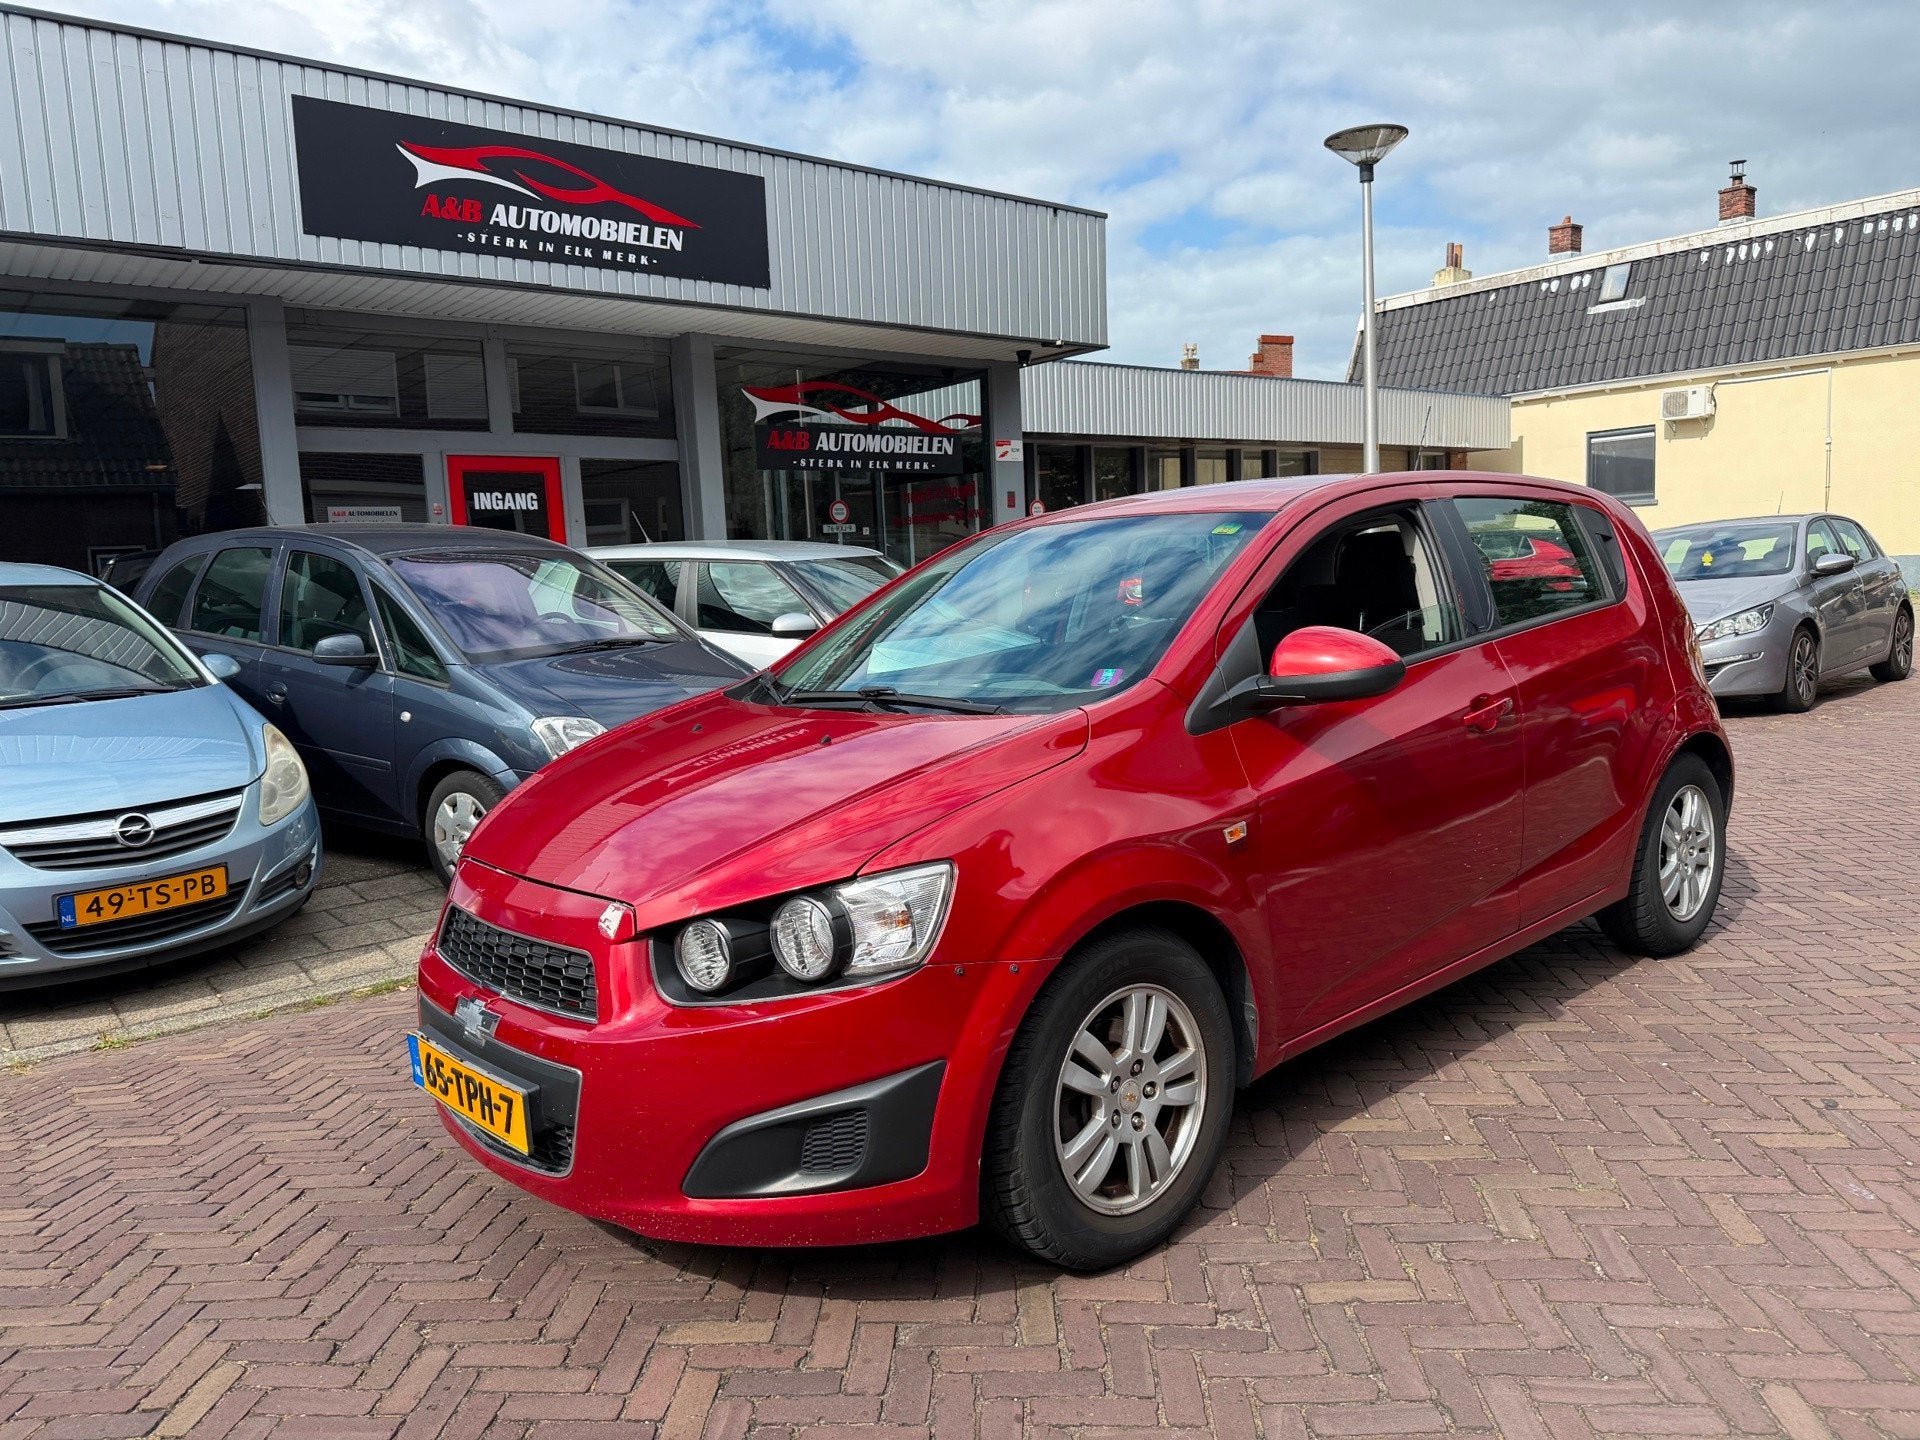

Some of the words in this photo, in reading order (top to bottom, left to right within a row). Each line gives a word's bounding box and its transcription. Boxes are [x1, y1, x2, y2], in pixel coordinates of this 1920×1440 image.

[421, 193, 483, 224] A&B
[489, 203, 684, 251] AUTOMOBIELEN
[538, 241, 554, 253] IN
[564, 245, 593, 258] ELK
[767, 430, 810, 450] A&B
[815, 432, 954, 455] AUTOMOBIELEN
[850, 459, 862, 469] IN
[868, 460, 889, 469] ELK
[473, 492, 539, 511] INGANG
[61, 915, 75, 923] NL
[426, 1053, 513, 1134] 65-TPH-7
